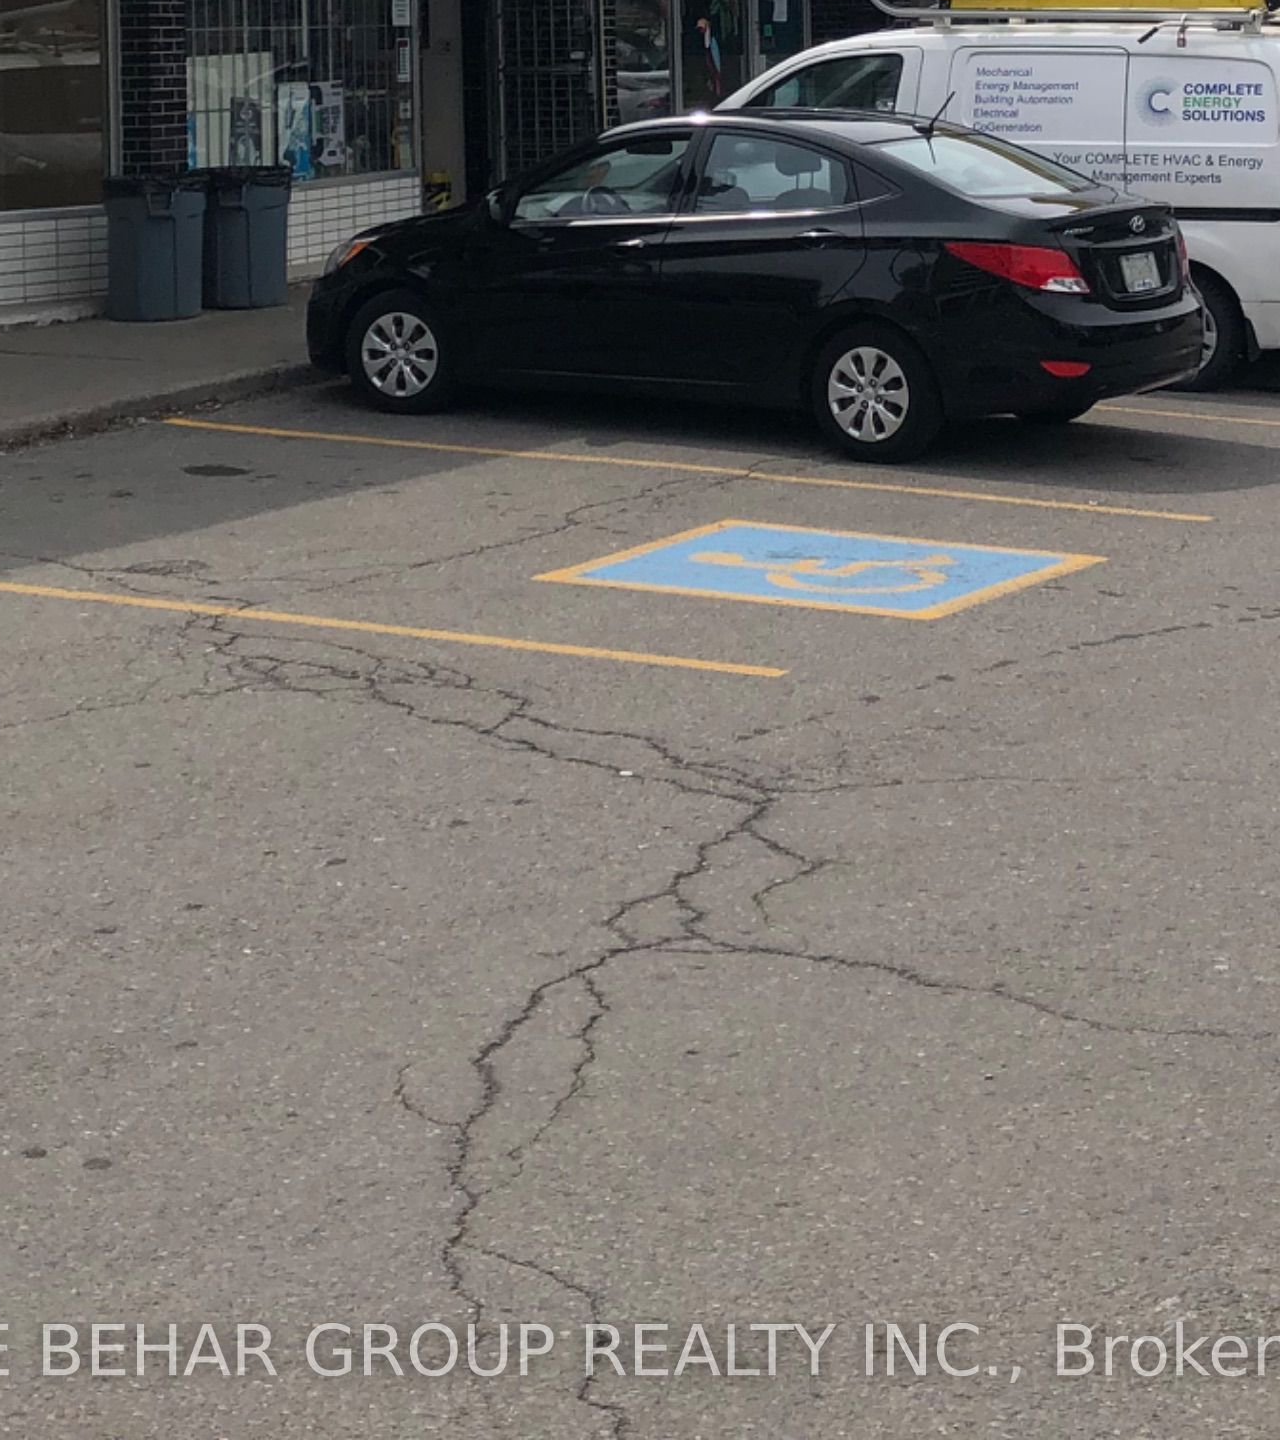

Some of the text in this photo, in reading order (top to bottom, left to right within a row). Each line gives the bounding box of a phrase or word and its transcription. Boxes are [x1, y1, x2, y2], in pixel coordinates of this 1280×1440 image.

[976, 67, 1033, 77] Mechanical
[975, 80, 1079, 92] Energy Management
[1183, 83, 1263, 96] COMPLETE
[975, 94, 1073, 105] Building Automation
[1183, 97, 1242, 108] ENERGY
[973, 108, 1019, 118] Electrical
[1182, 110, 1266, 122] SOLUTIONS
[973, 122, 1042, 132] CoGeneration
[1052, 152, 1264, 170] Your COMPLETE HVAC & Energy
[1091, 170, 1222, 184] Management Experts
